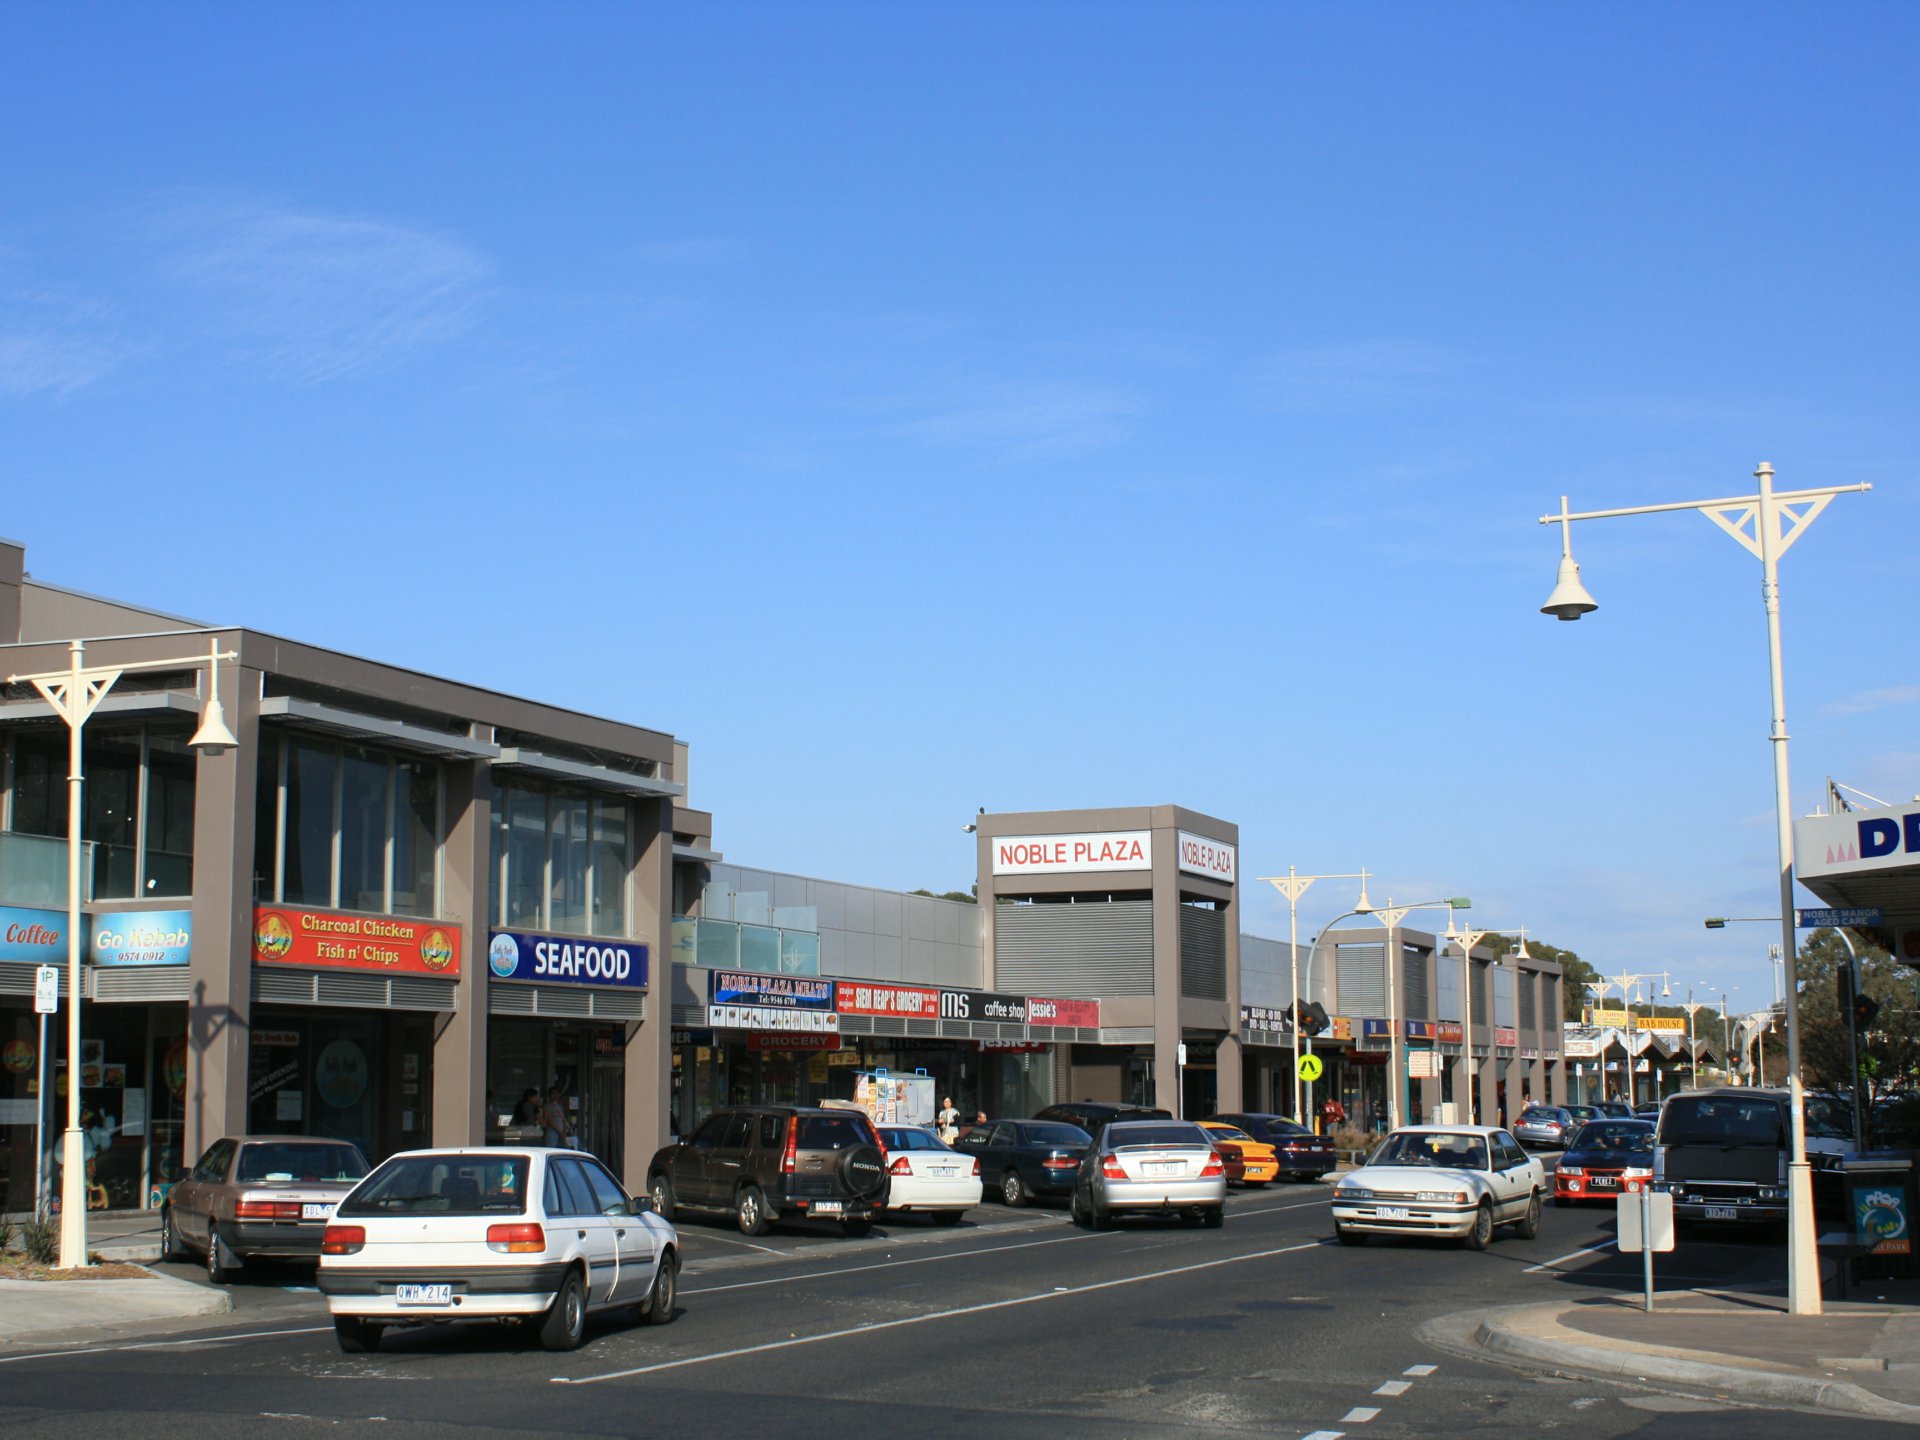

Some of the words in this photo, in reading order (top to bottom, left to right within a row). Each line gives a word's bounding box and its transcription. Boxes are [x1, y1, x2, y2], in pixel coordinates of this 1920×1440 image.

[1000, 843, 1067, 865] NOBLE
[1074, 840, 1144, 862] PLAZA
[1181, 840, 1207, 868] NOBLE
[1207, 846, 1232, 874] PLAZA
[1803, 909, 1838, 919] NOBLE
[1841, 908, 1879, 917] MANOR
[1813, 917, 1839, 926] AGED
[1841, 917, 1868, 925] CARE
[6, 922, 59, 945] Coffee
[301, 914, 360, 935] Charcoal
[363, 920, 414, 939] Chicken
[96, 930, 124, 950] Go
[129, 928, 190, 948] Kebab
[117, 952, 140, 961] 9574
[142, 951, 165, 961] 0912
[316, 942, 345, 959] Fish
[363, 945, 399, 965] Chips
[534, 941, 631, 980] SEAFOOD
[720, 974, 758, 993] NOBLE
[760, 978, 793, 996] PLAZA
[794, 980, 828, 999] MEATS
[855, 987, 872, 1009] SIEM
[873, 989, 895, 1011] REAP'S
[896, 990, 923, 1012] GROCERY
[984, 1001, 1007, 1017] coffee
[1008, 1002, 1025, 1022] shop
[1028, 1000, 1057, 1022] Jessie's
[1658, 1018, 1681, 1029] HOUSE
[760, 1036, 828, 1046] GROCERY
[852, 1162, 880, 1171] HONDA
[304, 1206, 319, 1215] XDL
[427, 1286, 449, 1299] 214
